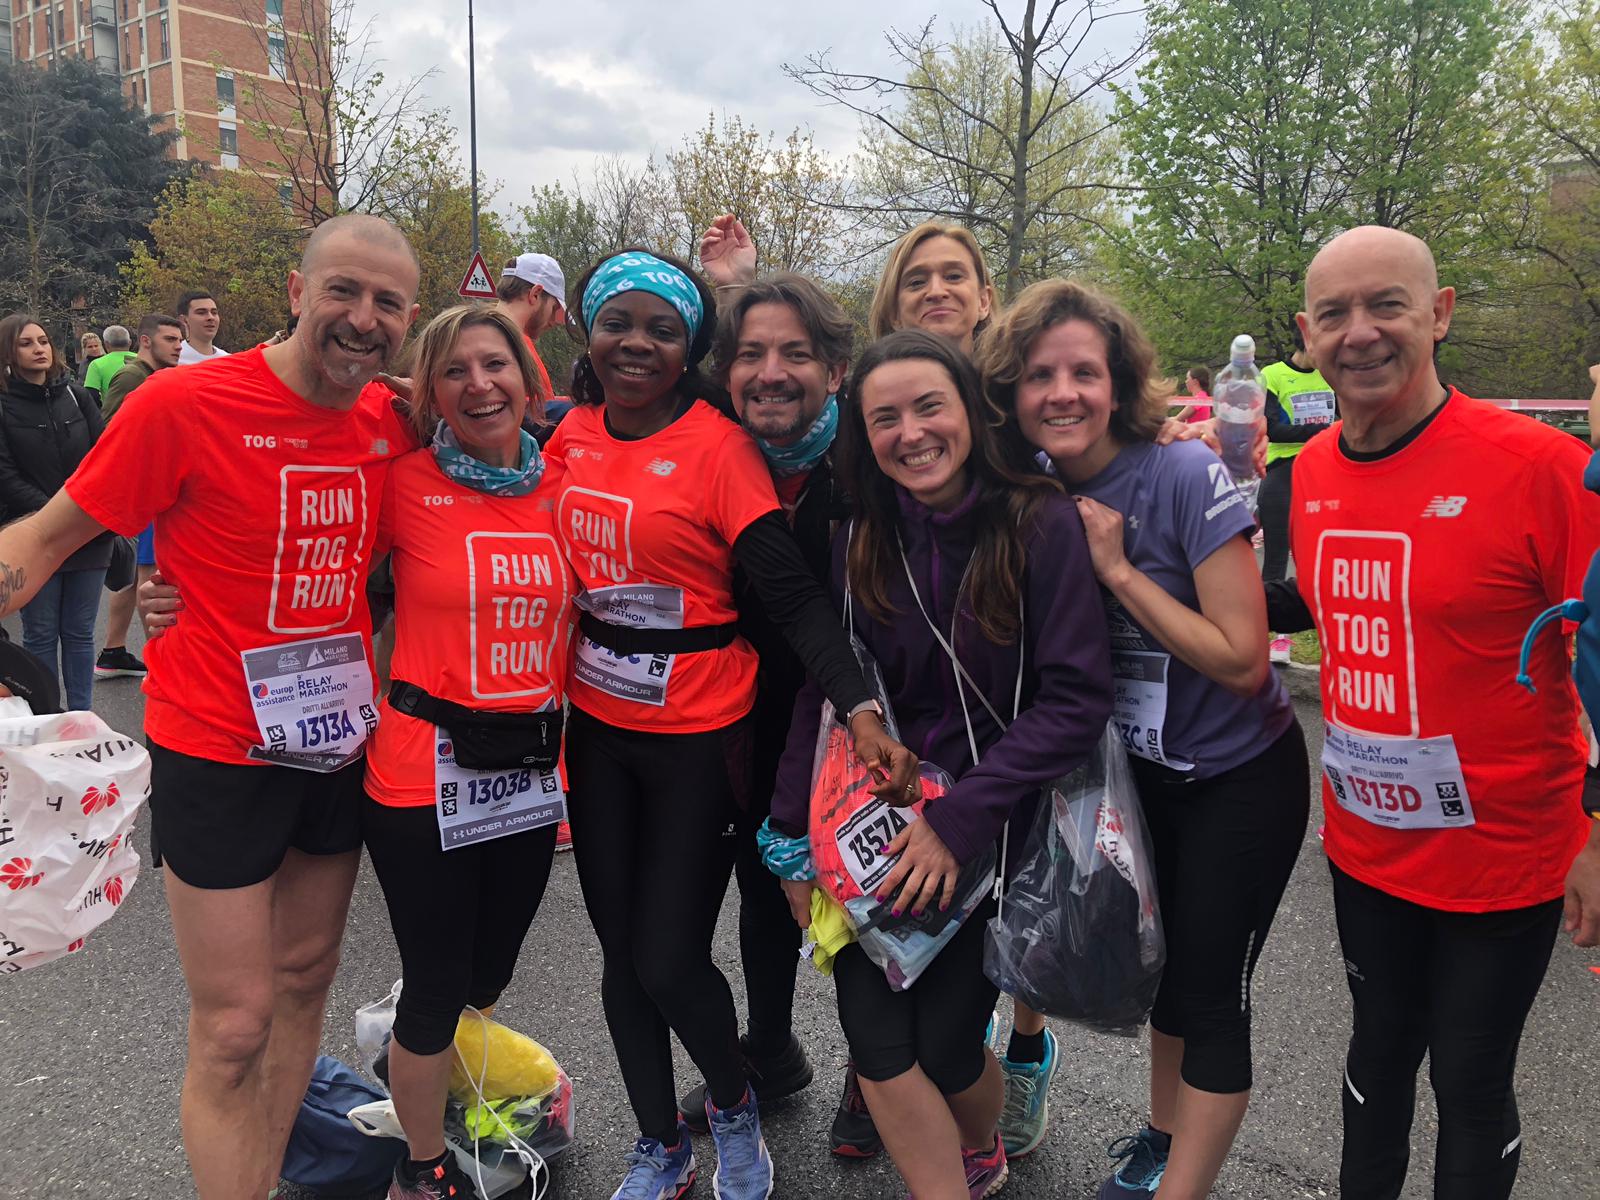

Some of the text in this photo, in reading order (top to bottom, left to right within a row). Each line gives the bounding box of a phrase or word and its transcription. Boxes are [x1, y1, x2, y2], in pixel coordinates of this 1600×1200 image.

[640, 271, 688, 290] TOG
[243, 434, 277, 448] TOG
[301, 488, 354, 526] RUN
[423, 495, 454, 506] TOG
[571, 508, 617, 550] RUN
[296, 536, 347, 570] TOG
[491, 553, 552, 586] RUN
[291, 573, 346, 609] RUN
[1332, 558, 1391, 602] RUN
[492, 596, 548, 629] TOG
[623, 593, 655, 601] MILANO
[323, 645, 348, 655] MILANO
[1332, 612, 1390, 658] TOG
[491, 640, 543, 676] RUN
[270, 685, 294, 696] europ
[297, 675, 332, 691] RELAY
[299, 682, 348, 699] MARATHON
[578, 666, 651, 696] UNDER ARMOUR
[1338, 666, 1396, 714] RUN
[256, 693, 295, 708] assistance
[296, 709, 357, 749] 1313A
[1346, 741, 1382, 755] RELAY
[1348, 750, 1408, 765] MARATHON
[467, 769, 532, 806] 1303B
[1347, 774, 1422, 812] 1313D
[466, 809, 554, 836] UNDER ARMOUR
[847, 808, 909, 870] 1357A
